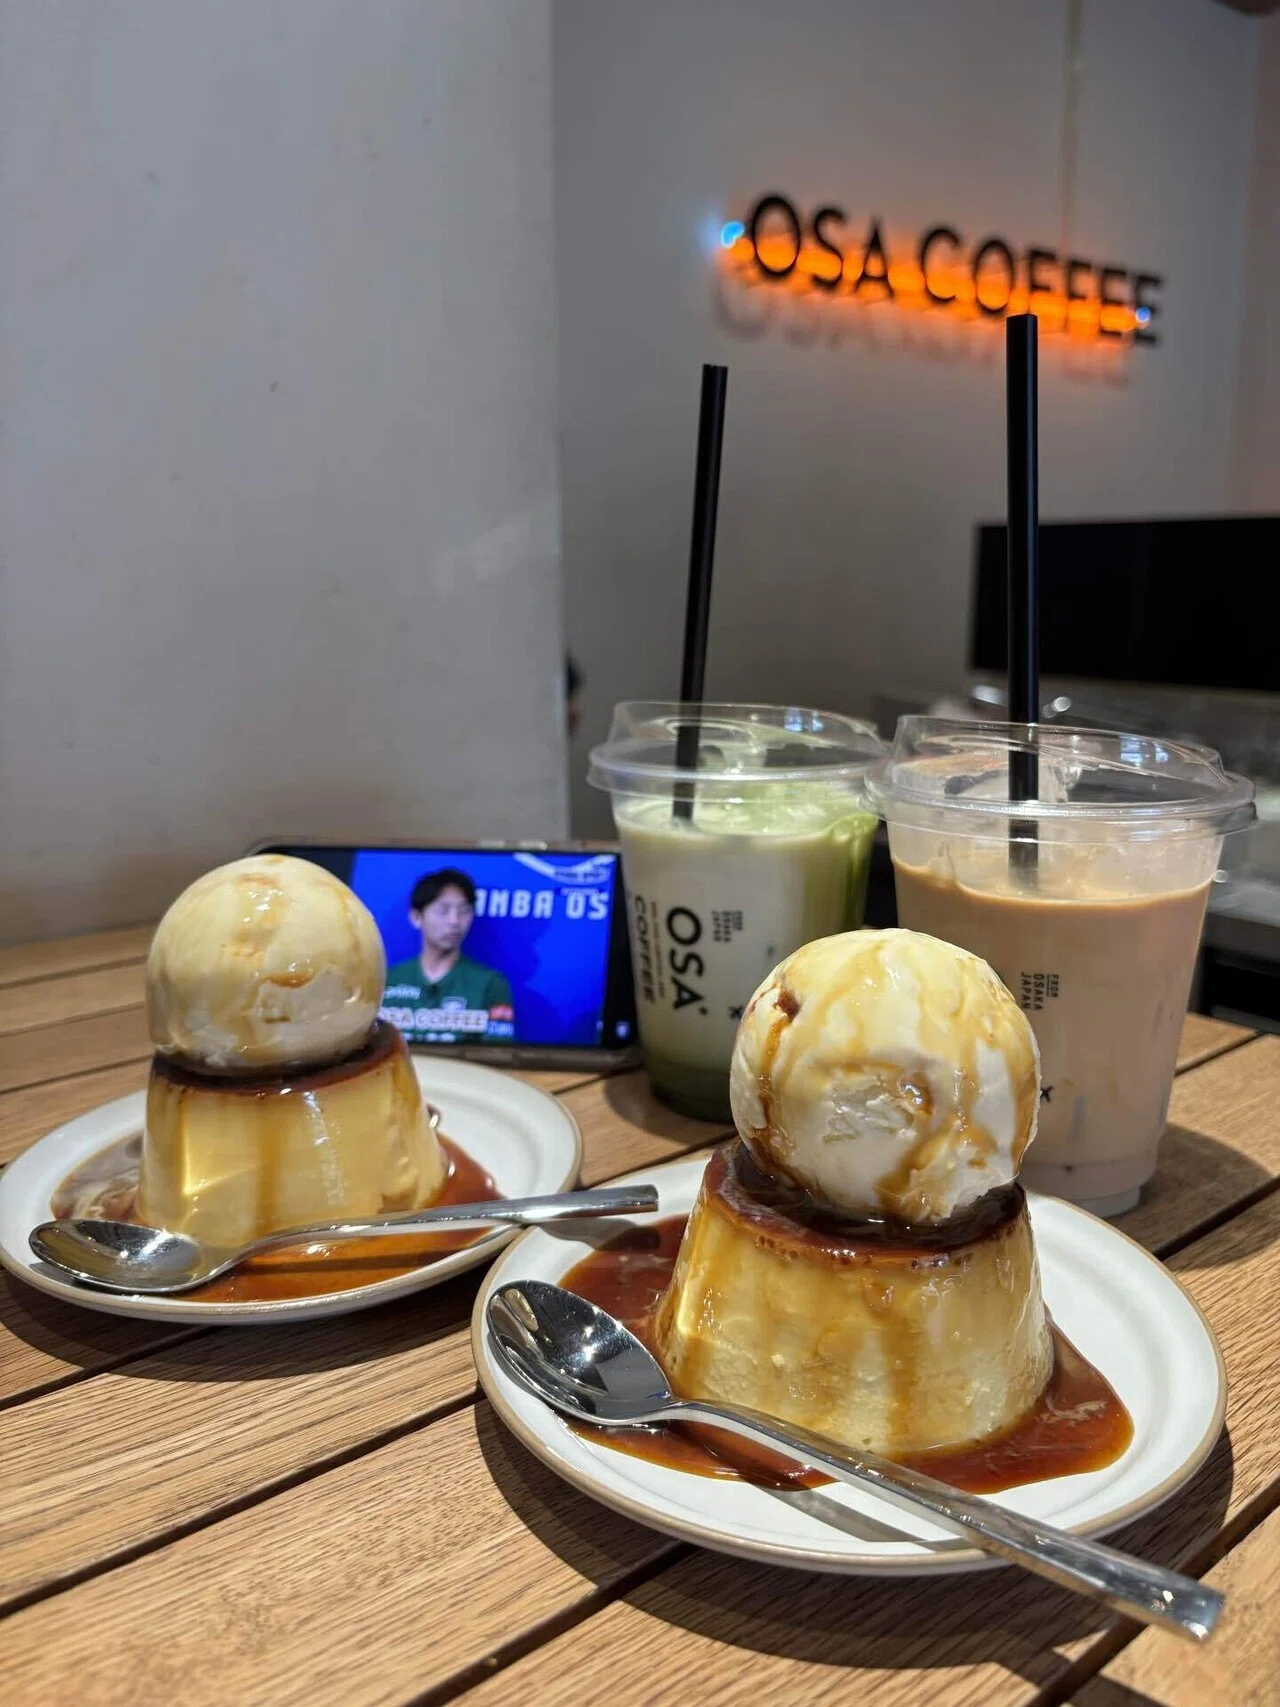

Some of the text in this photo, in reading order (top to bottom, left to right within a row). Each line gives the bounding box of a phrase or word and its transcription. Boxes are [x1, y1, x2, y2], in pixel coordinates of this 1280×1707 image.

[747, 196, 1163, 344] OSA COFFEE
[634, 895, 656, 1003] COFFEE
[666, 906, 705, 1011] OSA
[1020, 971, 1032, 1010] JAPAN
[1034, 974, 1045, 1010] OSAKA
